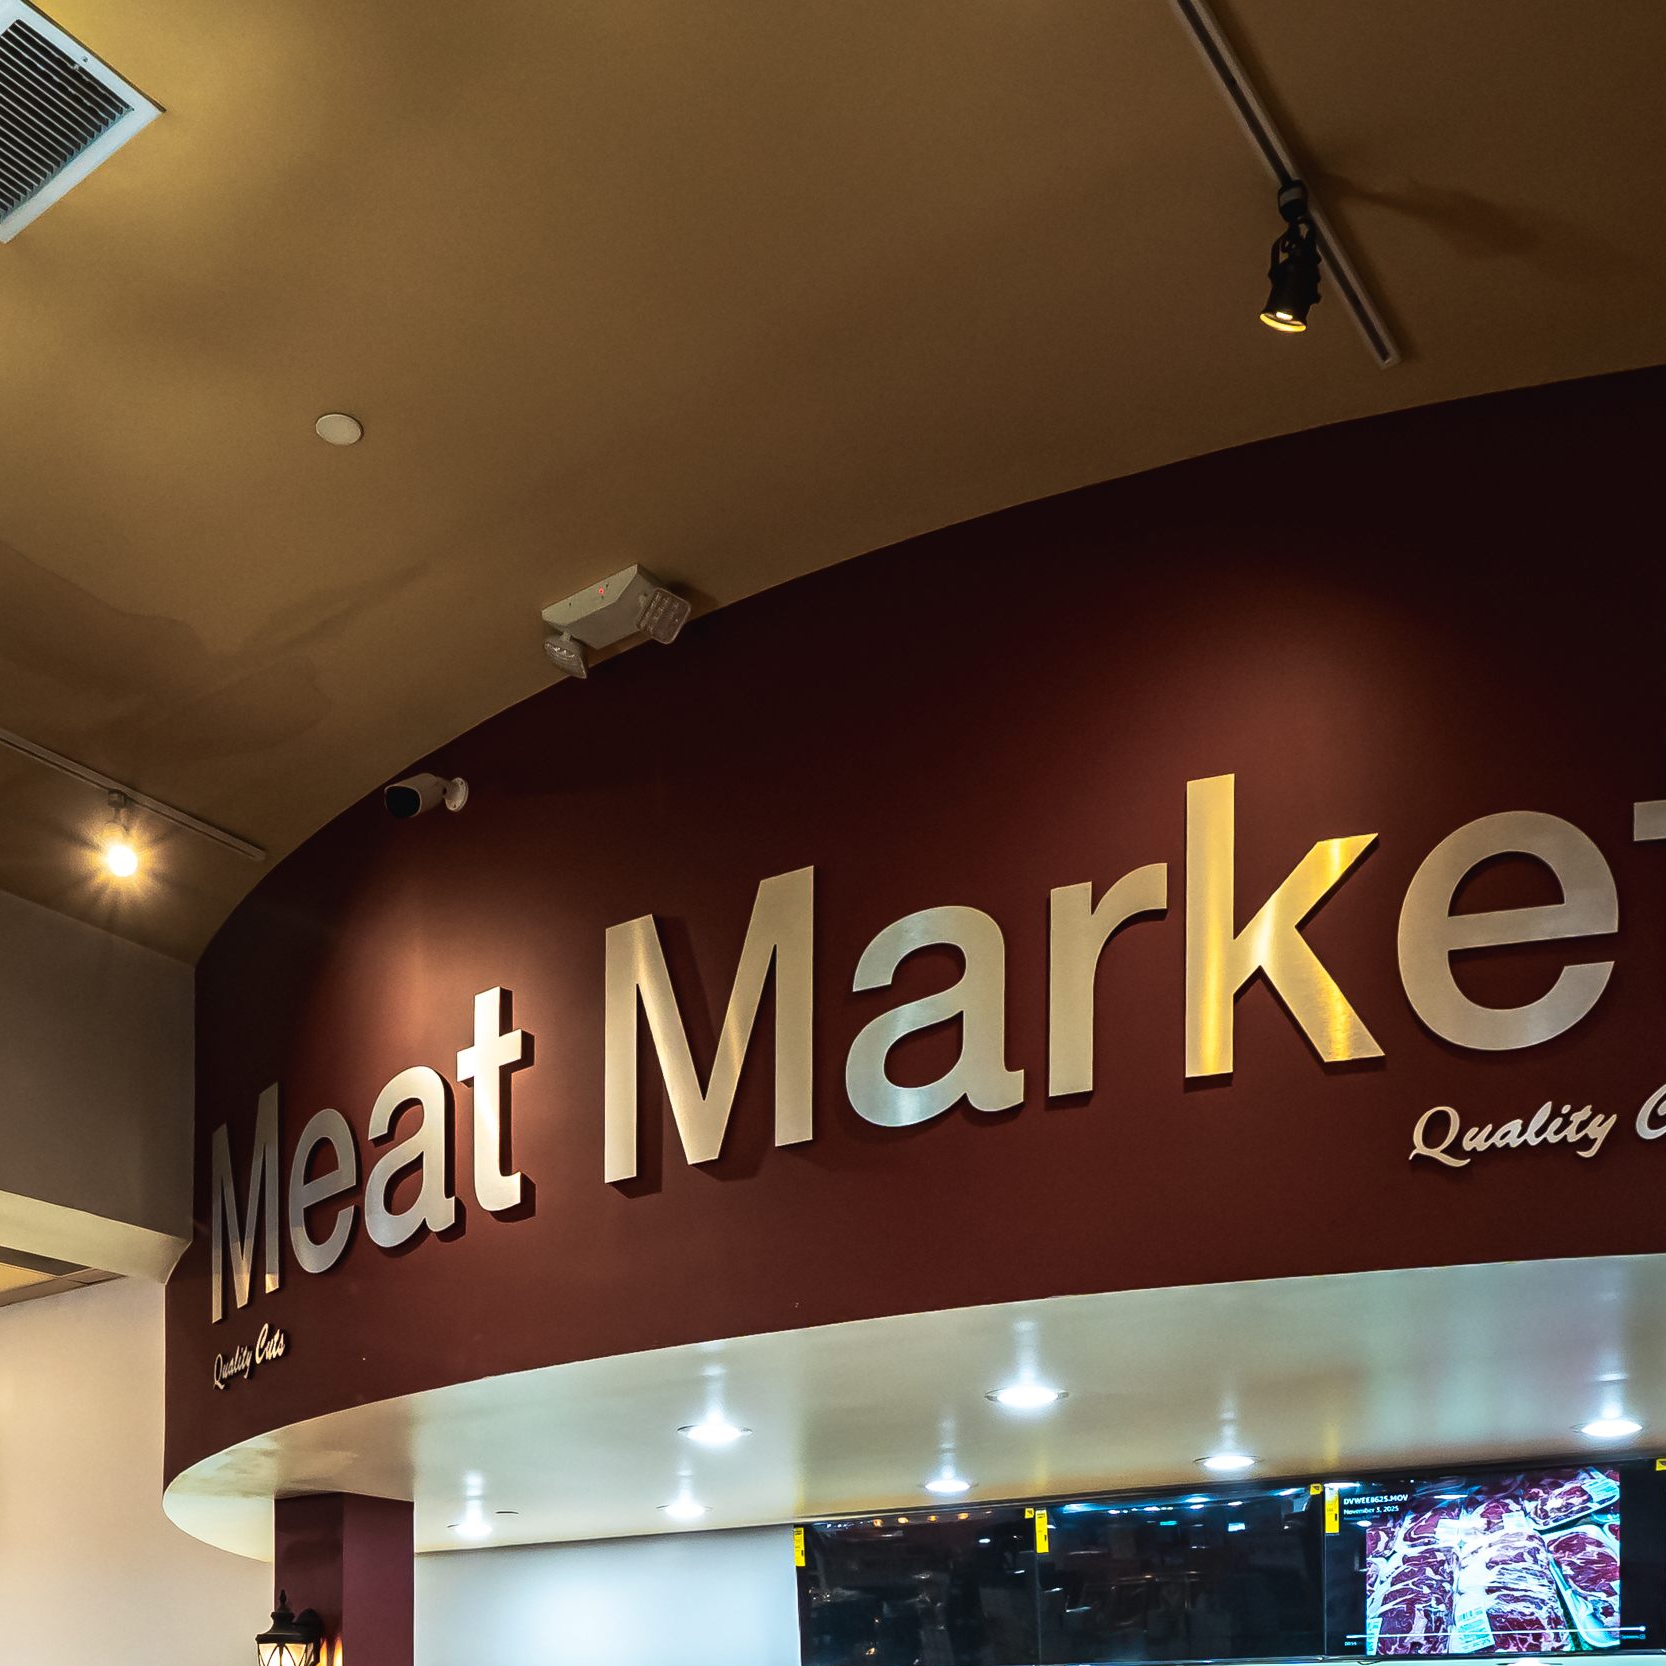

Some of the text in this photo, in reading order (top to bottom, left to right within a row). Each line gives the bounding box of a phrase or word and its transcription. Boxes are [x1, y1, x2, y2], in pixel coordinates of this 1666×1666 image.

[211, 988, 523, 1321] Meat
[1409, 1101, 1617, 1167] Quality
[213, 1323, 285, 1389] Quality Cuts
